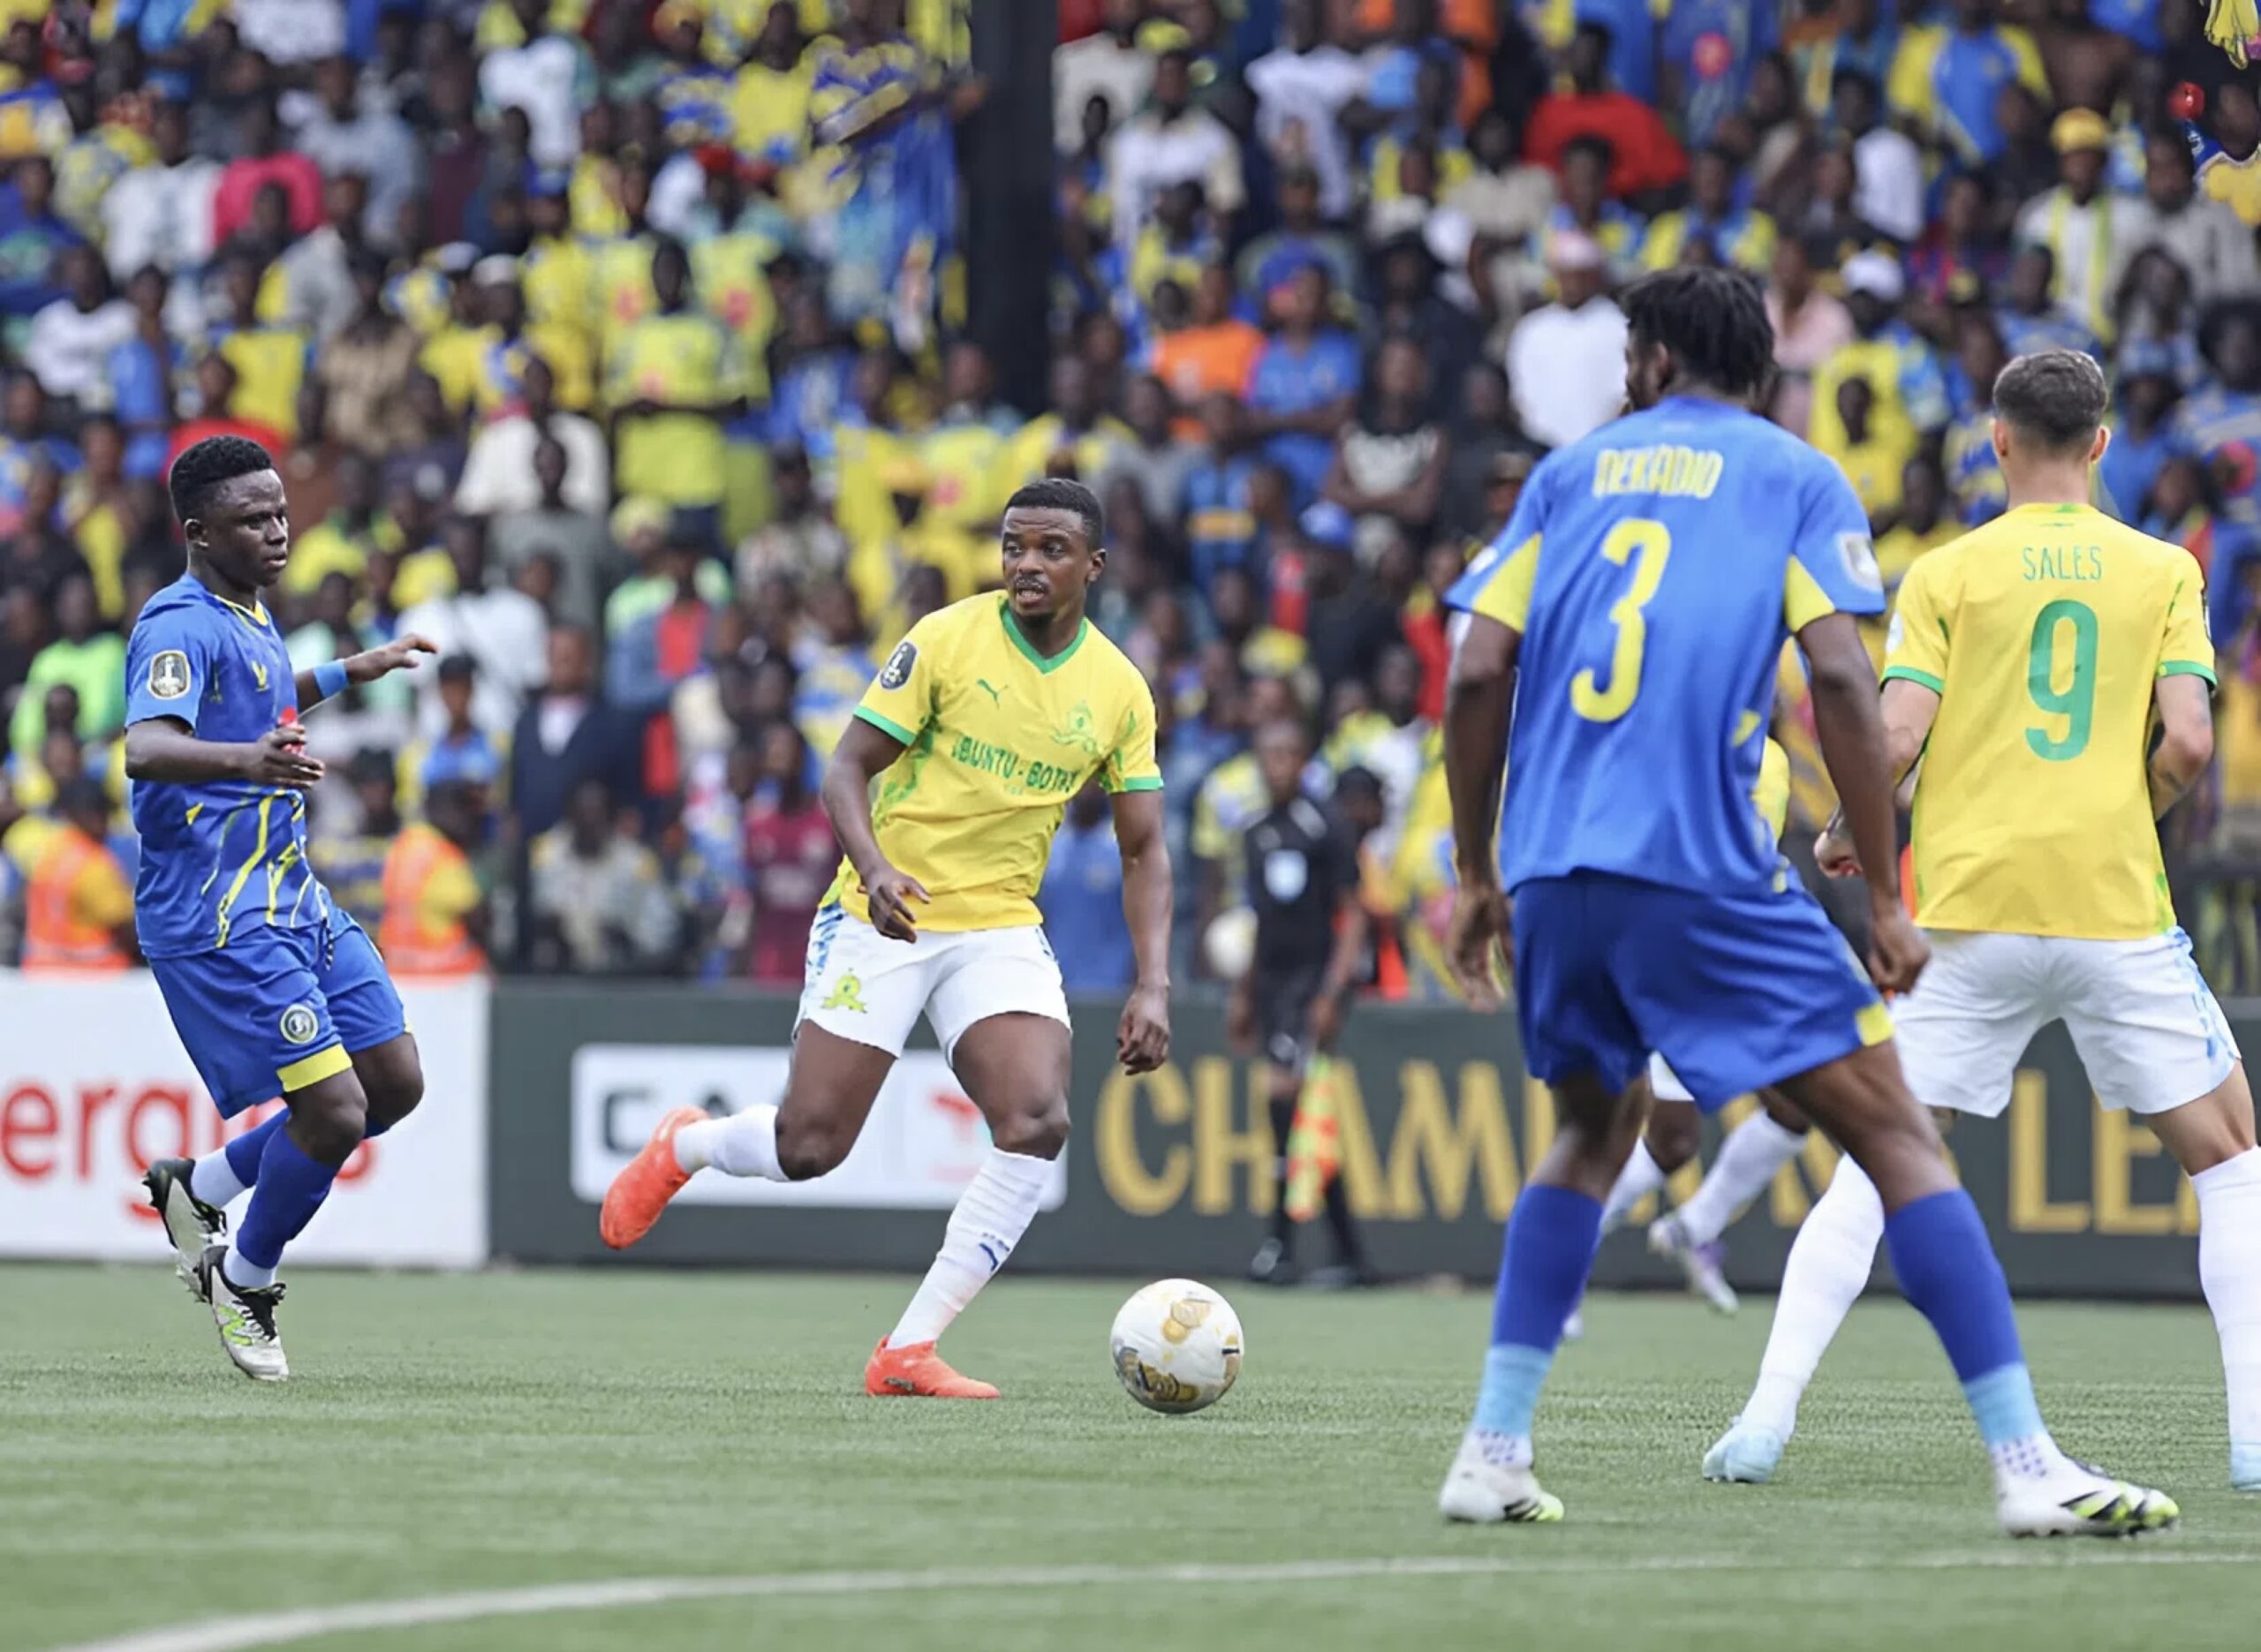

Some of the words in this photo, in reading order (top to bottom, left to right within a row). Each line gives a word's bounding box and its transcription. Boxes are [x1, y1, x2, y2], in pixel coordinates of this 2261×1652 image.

[1569, 517, 1671, 723] 3
[2022, 545, 2103, 580] SALES
[2025, 599, 2098, 761] 9
